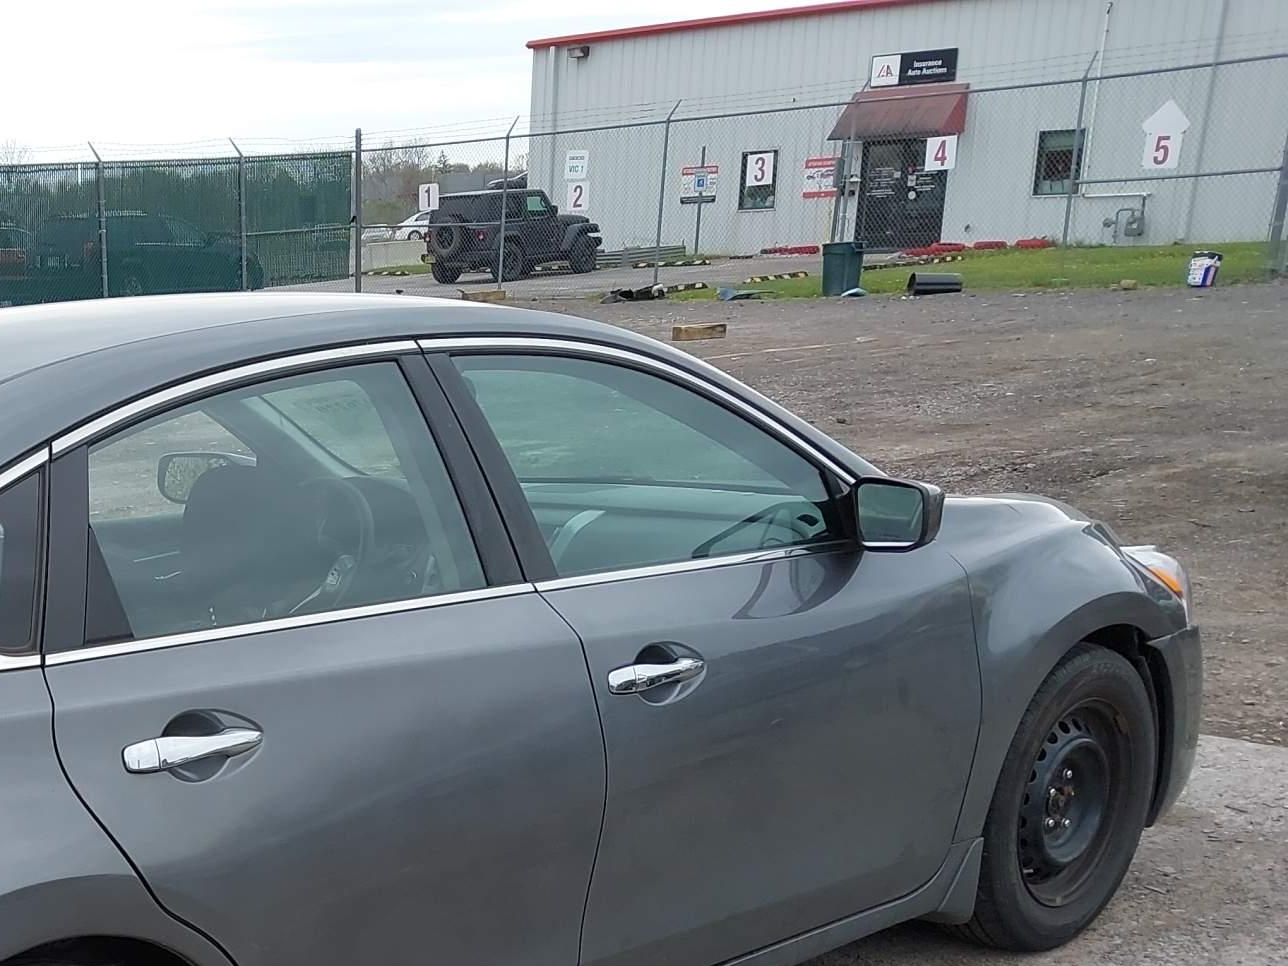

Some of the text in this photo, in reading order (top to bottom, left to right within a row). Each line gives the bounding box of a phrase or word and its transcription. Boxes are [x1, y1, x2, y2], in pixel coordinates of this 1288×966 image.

[922, 67, 947, 75] Auctions
[934, 140, 947, 166] 4
[1153, 136, 1170, 165] 5
[569, 165, 578, 173] VIC
[754, 157, 766, 182] 3
[425, 186, 431, 208] 1
[572, 184, 583, 208] 2
